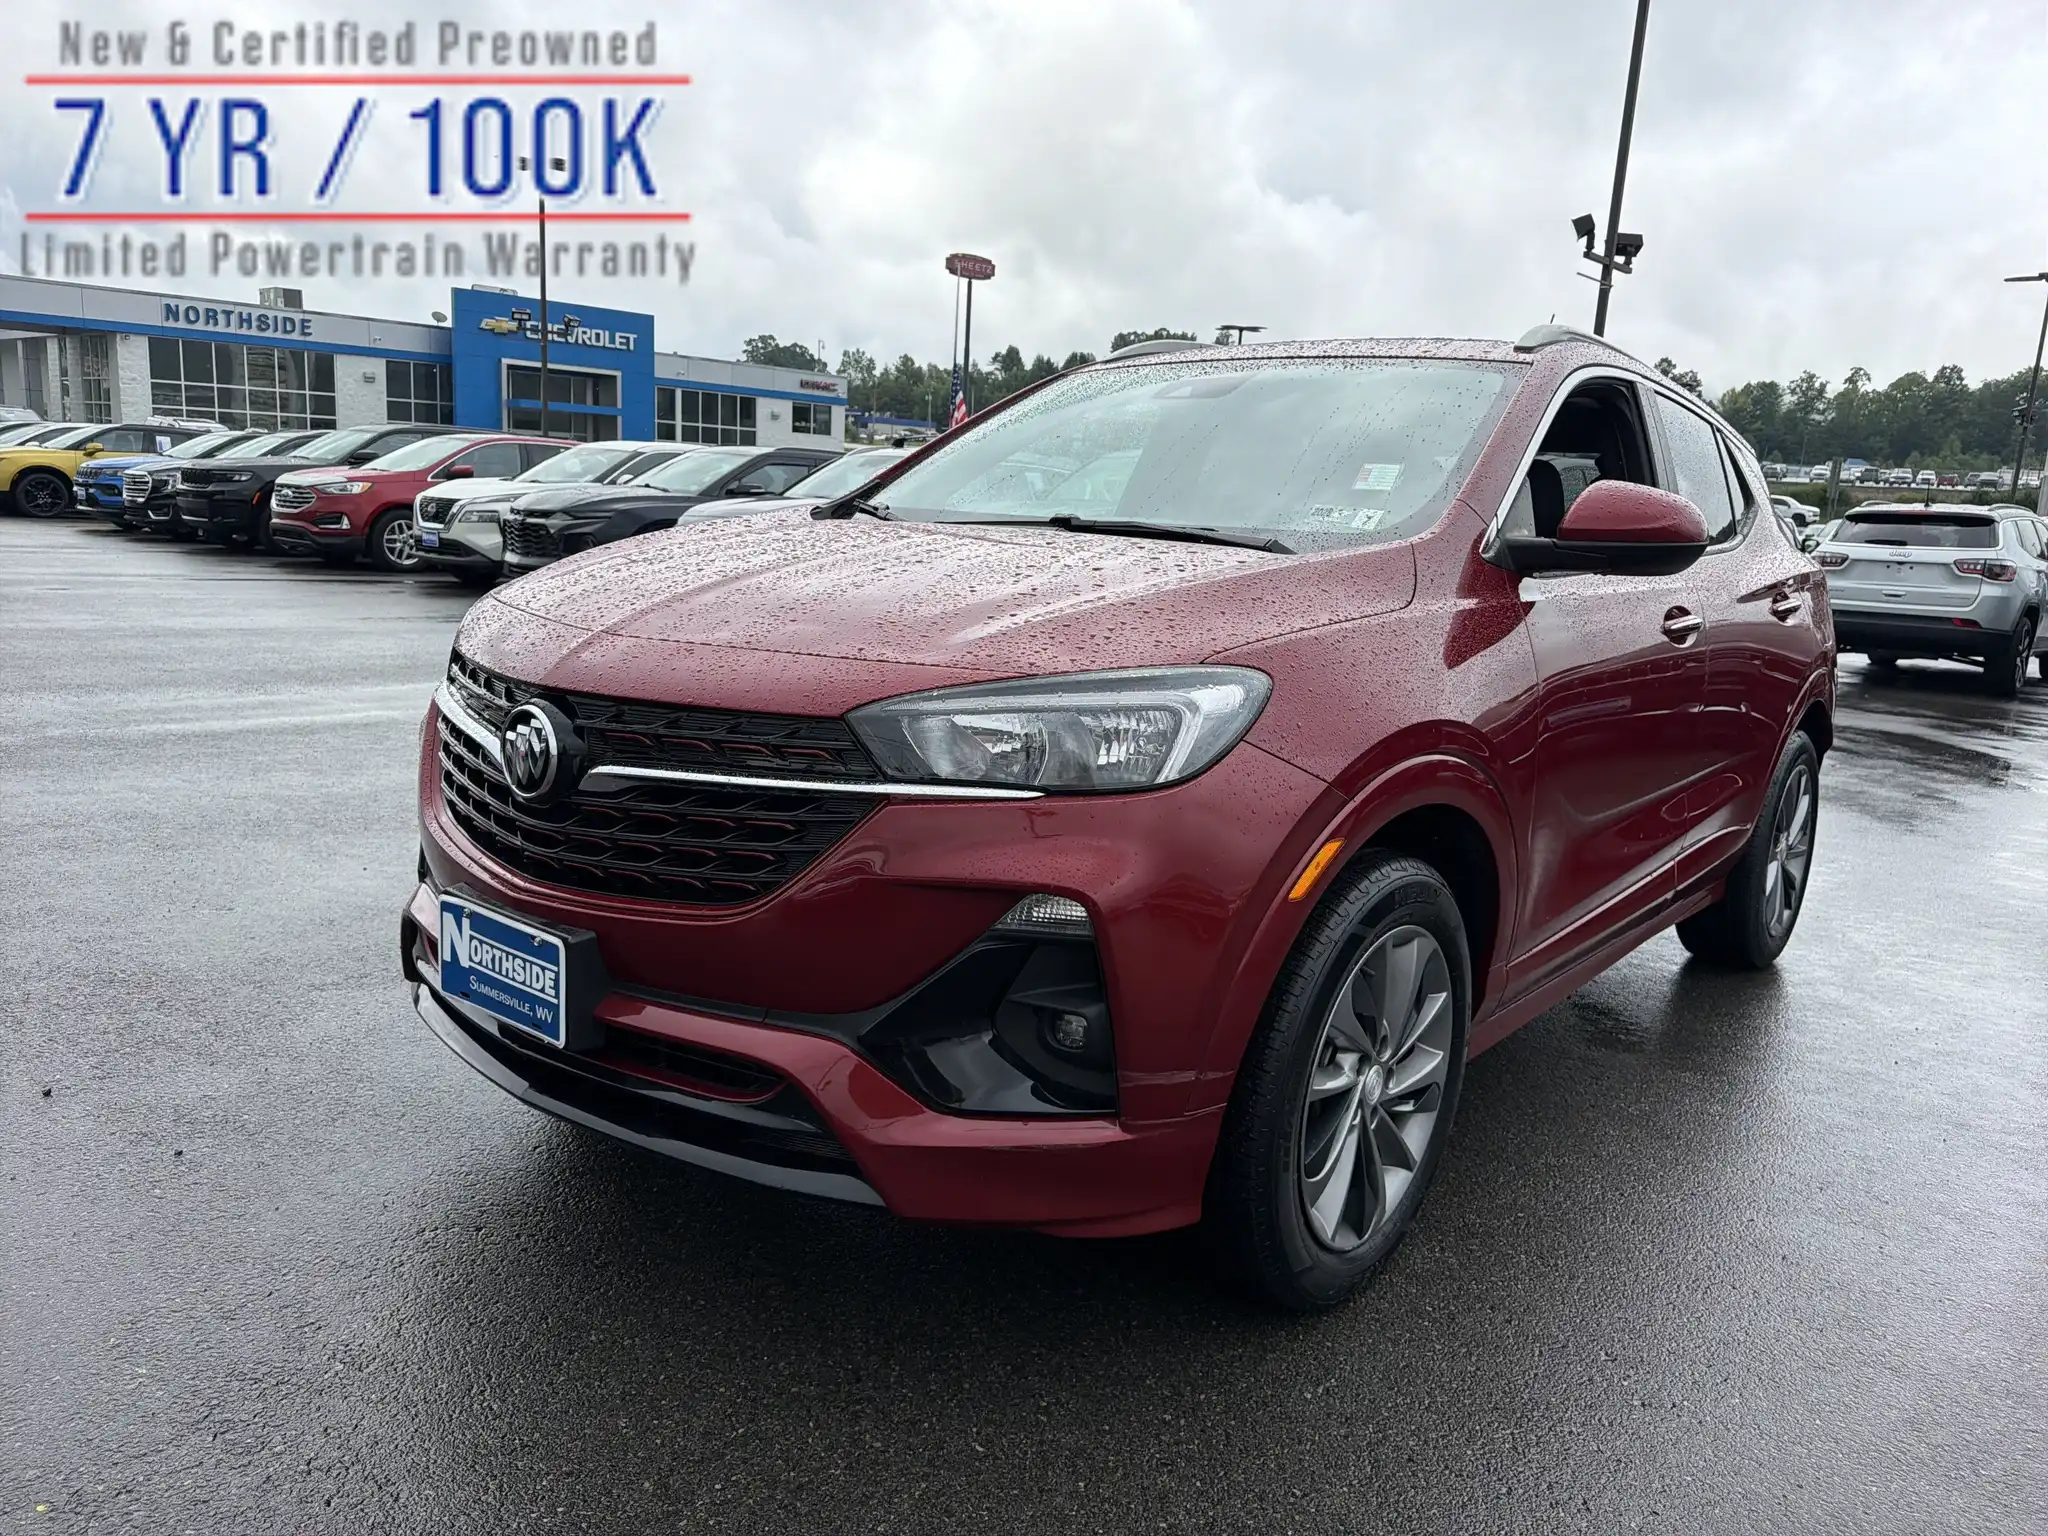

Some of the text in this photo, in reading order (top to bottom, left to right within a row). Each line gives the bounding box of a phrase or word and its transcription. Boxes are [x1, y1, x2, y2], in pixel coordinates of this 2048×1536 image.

[164, 302, 313, 337] NORTHSIDE
[442, 911, 555, 996] NORTHSIDE
[469, 975, 554, 1024] SUMMERSVILLE, WV
